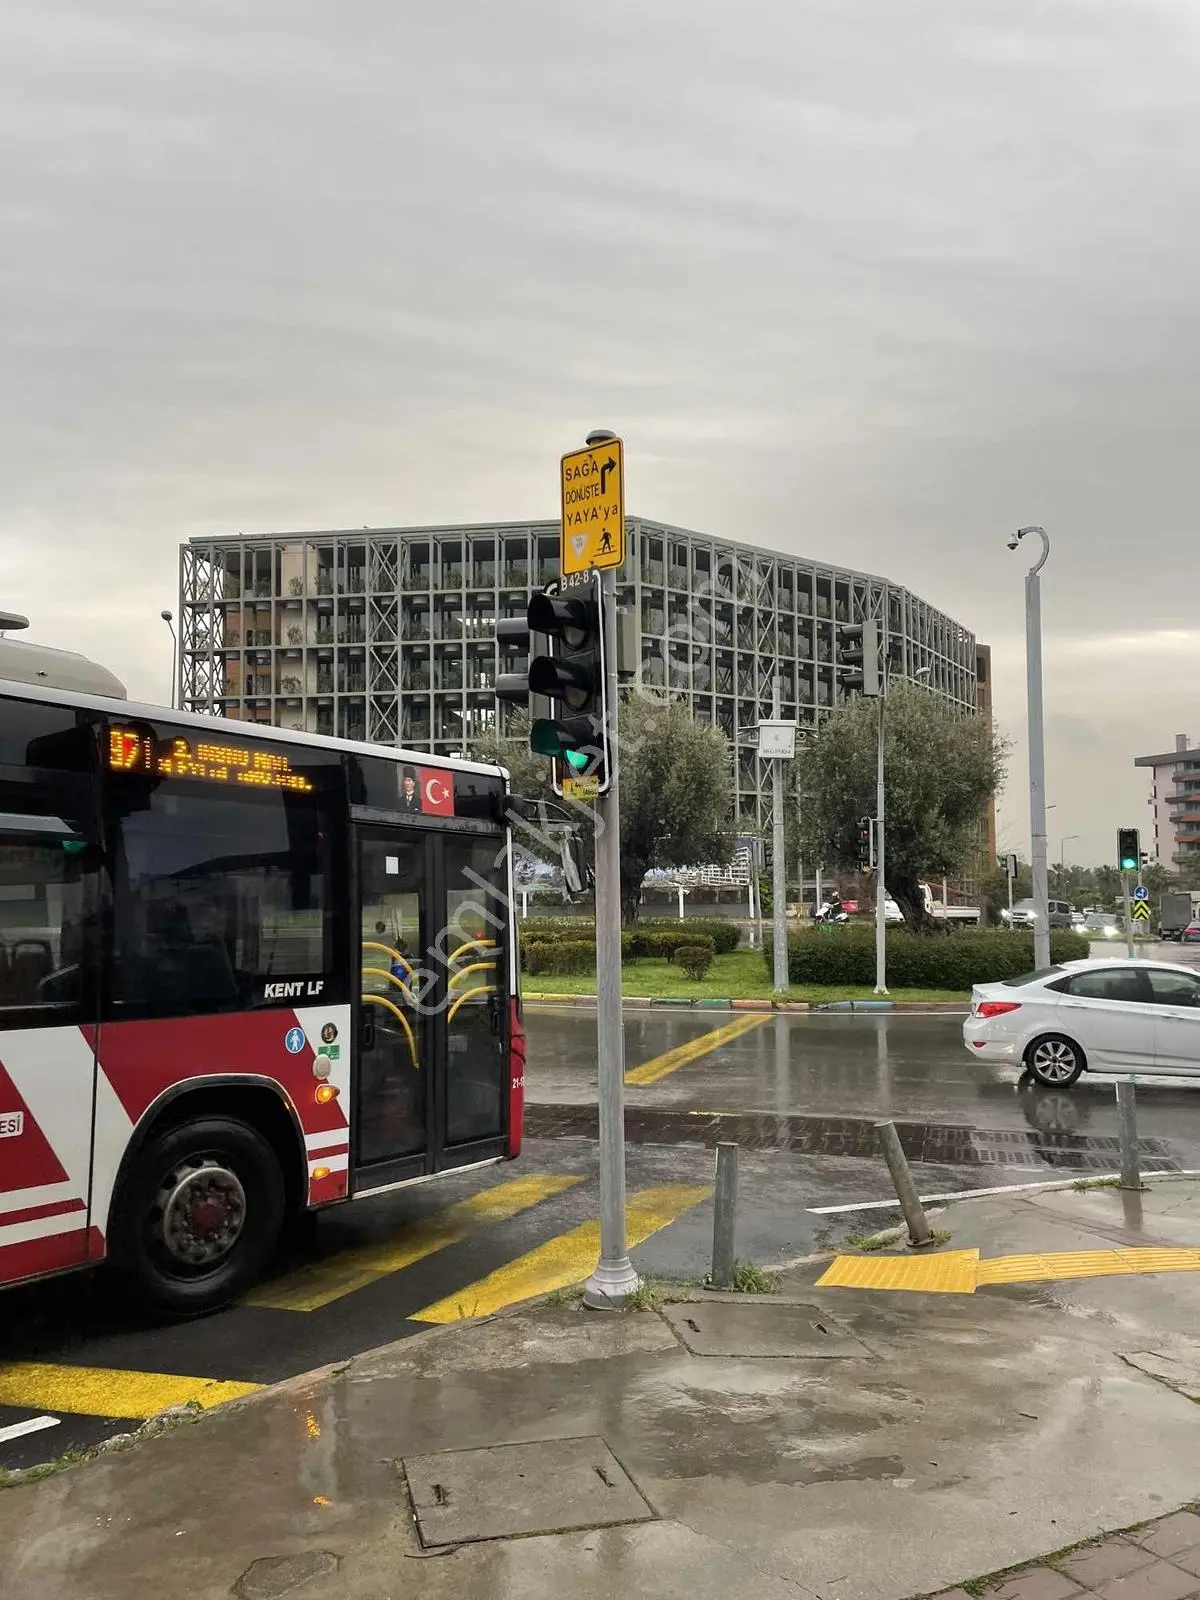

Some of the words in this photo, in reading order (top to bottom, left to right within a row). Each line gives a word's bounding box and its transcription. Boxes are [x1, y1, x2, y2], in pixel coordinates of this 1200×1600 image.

[565, 459, 599, 481] SAĞA
[566, 504, 618, 527] YAYA'ya
[264, 982, 305, 998] KENT
[307, 981, 324, 995] LF
